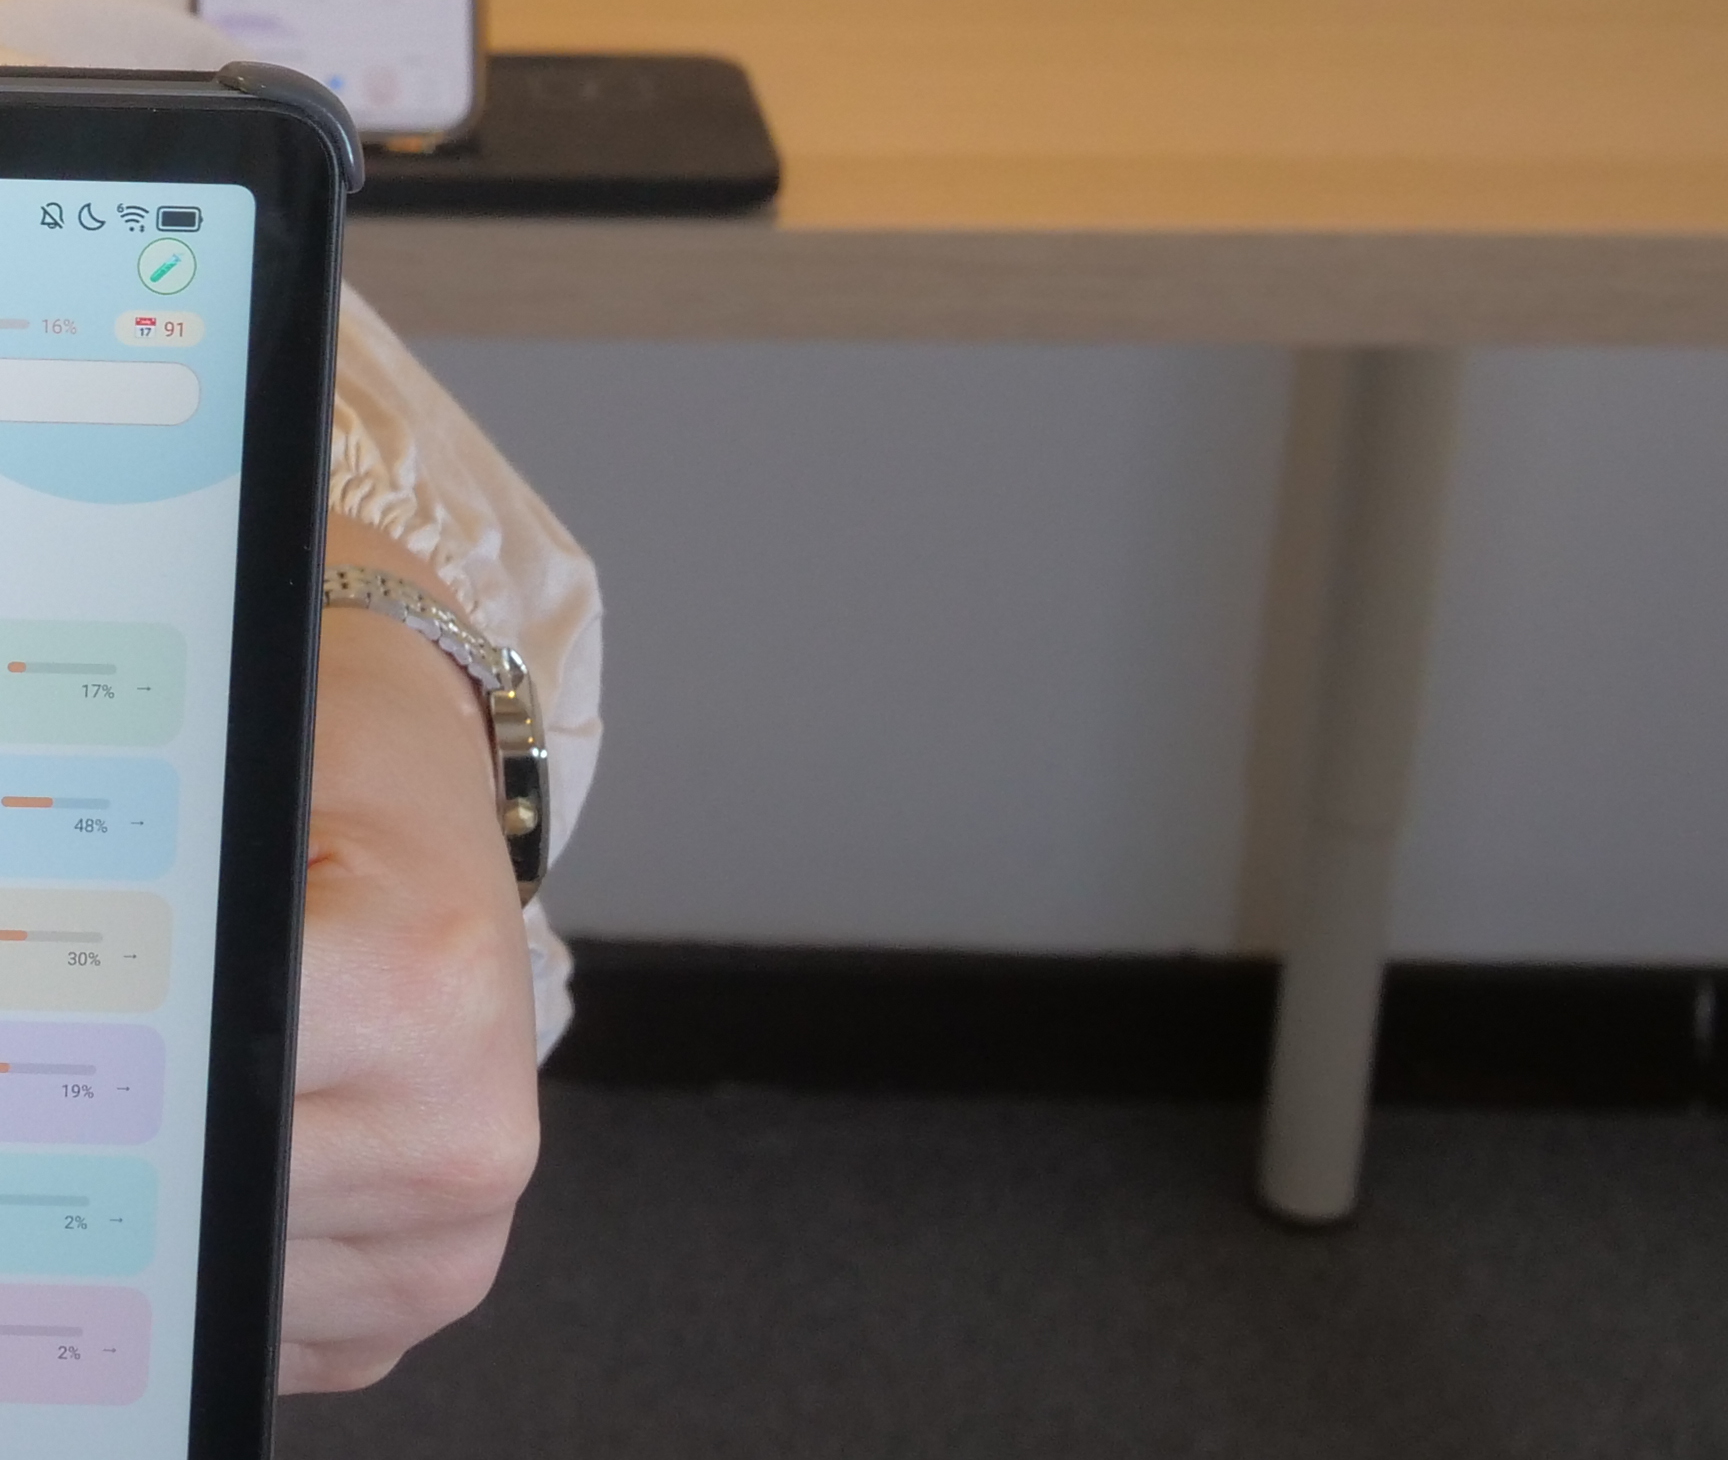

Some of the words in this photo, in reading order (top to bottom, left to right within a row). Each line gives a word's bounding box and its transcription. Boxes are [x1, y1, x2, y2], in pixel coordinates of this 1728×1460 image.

[43, 319, 76, 335] 16%
[164, 321, 183, 337] 91
[82, 684, 115, 699] 17%
[74, 818, 108, 833] 48%
[68, 952, 101, 966] 30%
[62, 1084, 94, 1098] 19%
[65, 1215, 87, 1229] 2%
[58, 1346, 81, 1360] 2%
